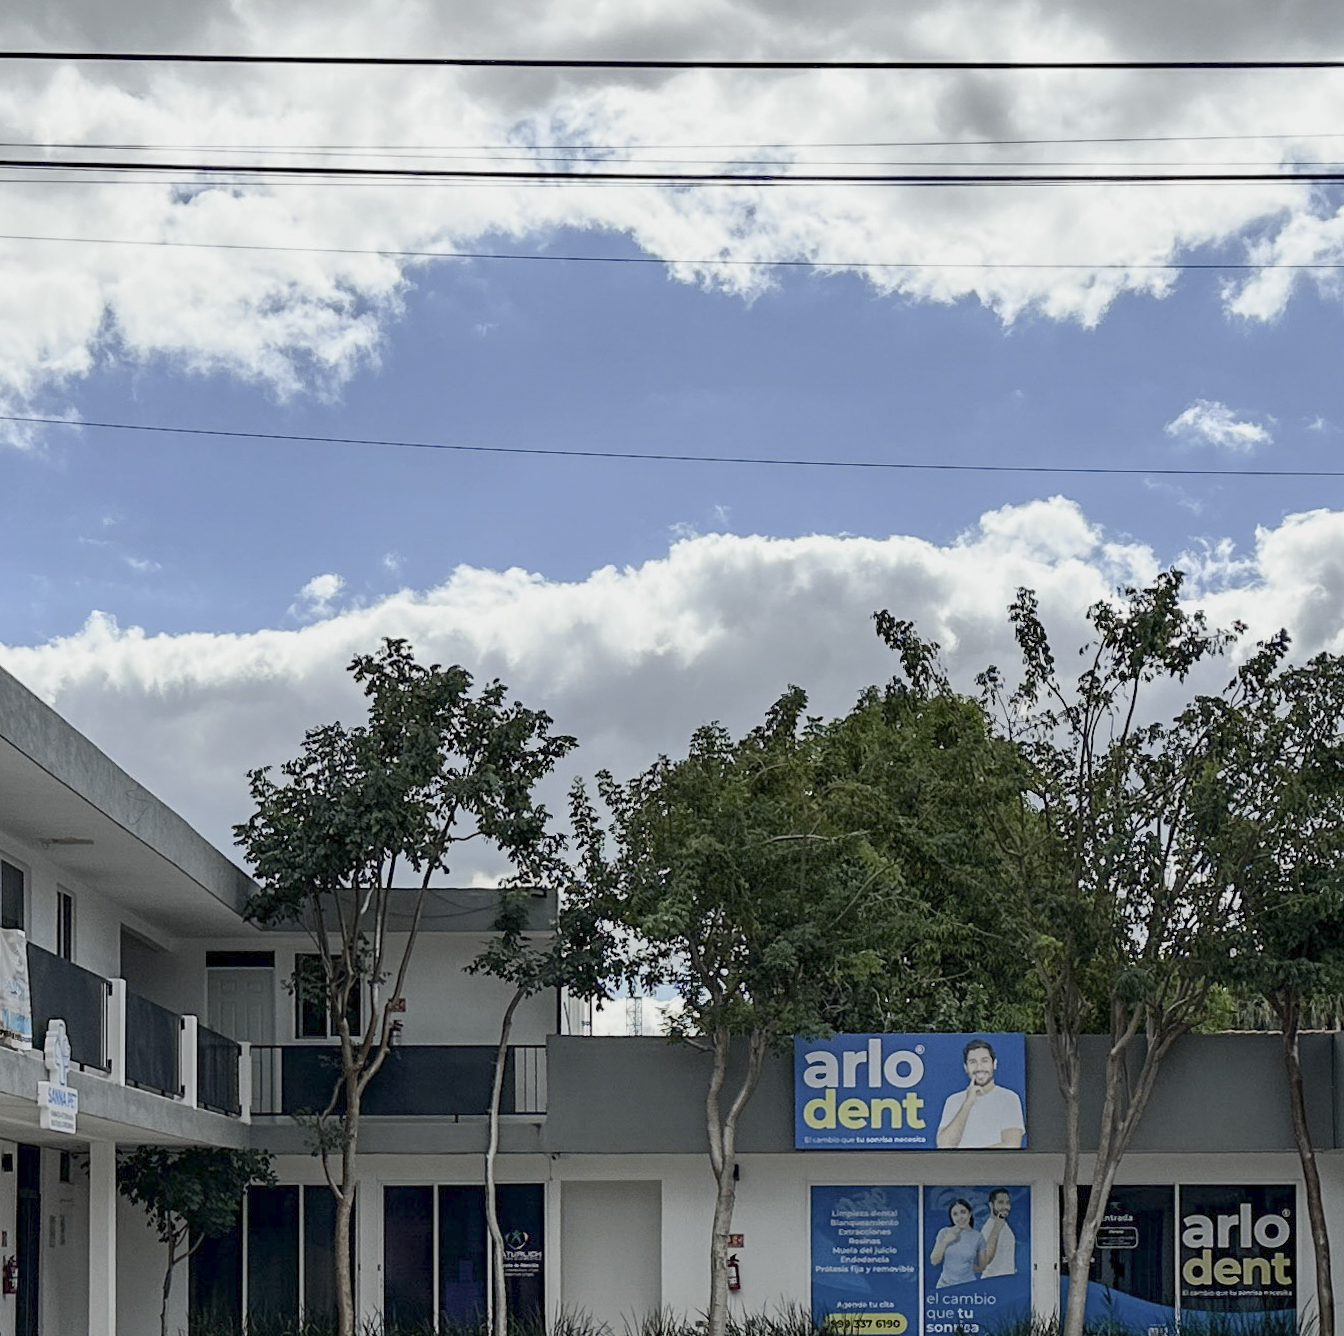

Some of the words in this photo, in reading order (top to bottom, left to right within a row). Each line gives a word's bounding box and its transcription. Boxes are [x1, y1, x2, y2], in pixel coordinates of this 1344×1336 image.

[803, 1038, 925, 1088] arlo
[803, 1088, 927, 1130] dent
[812, 1136, 841, 1144] cambio
[866, 1135, 893, 1143] sonrisa
[894, 1135, 927, 1143] necesita
[831, 1209, 869, 1218] Limpieza
[870, 1209, 898, 1217] dental
[1103, 1213, 1134, 1222] ntrada
[830, 1218, 899, 1227] Blanqueamiento
[1181, 1203, 1291, 1248] arlo
[838, 1228, 892, 1236] Extracciones
[848, 1237, 882, 1245] Resinas
[832, 1246, 858, 1254] Muela
[859, 1246, 873, 1254] del
[874, 1246, 898, 1255] juicio
[815, 1265, 849, 1273] Prótesis
[850, 1265, 864, 1274] fija
[865, 1266, 871, 1274] y
[872, 1265, 915, 1273] removible
[1182, 1249, 1293, 1286] dent
[926, 1293, 939, 1305] el
[942, 1291, 997, 1305] cambio
[869, 1301, 878, 1309] tu
[879, 1301, 895, 1309] cita
[926, 1309, 955, 1321] que
[958, 1308, 974, 1319] tu
[853, 1319, 873, 1328] 337
[875, 1319, 901, 1328] 6190
